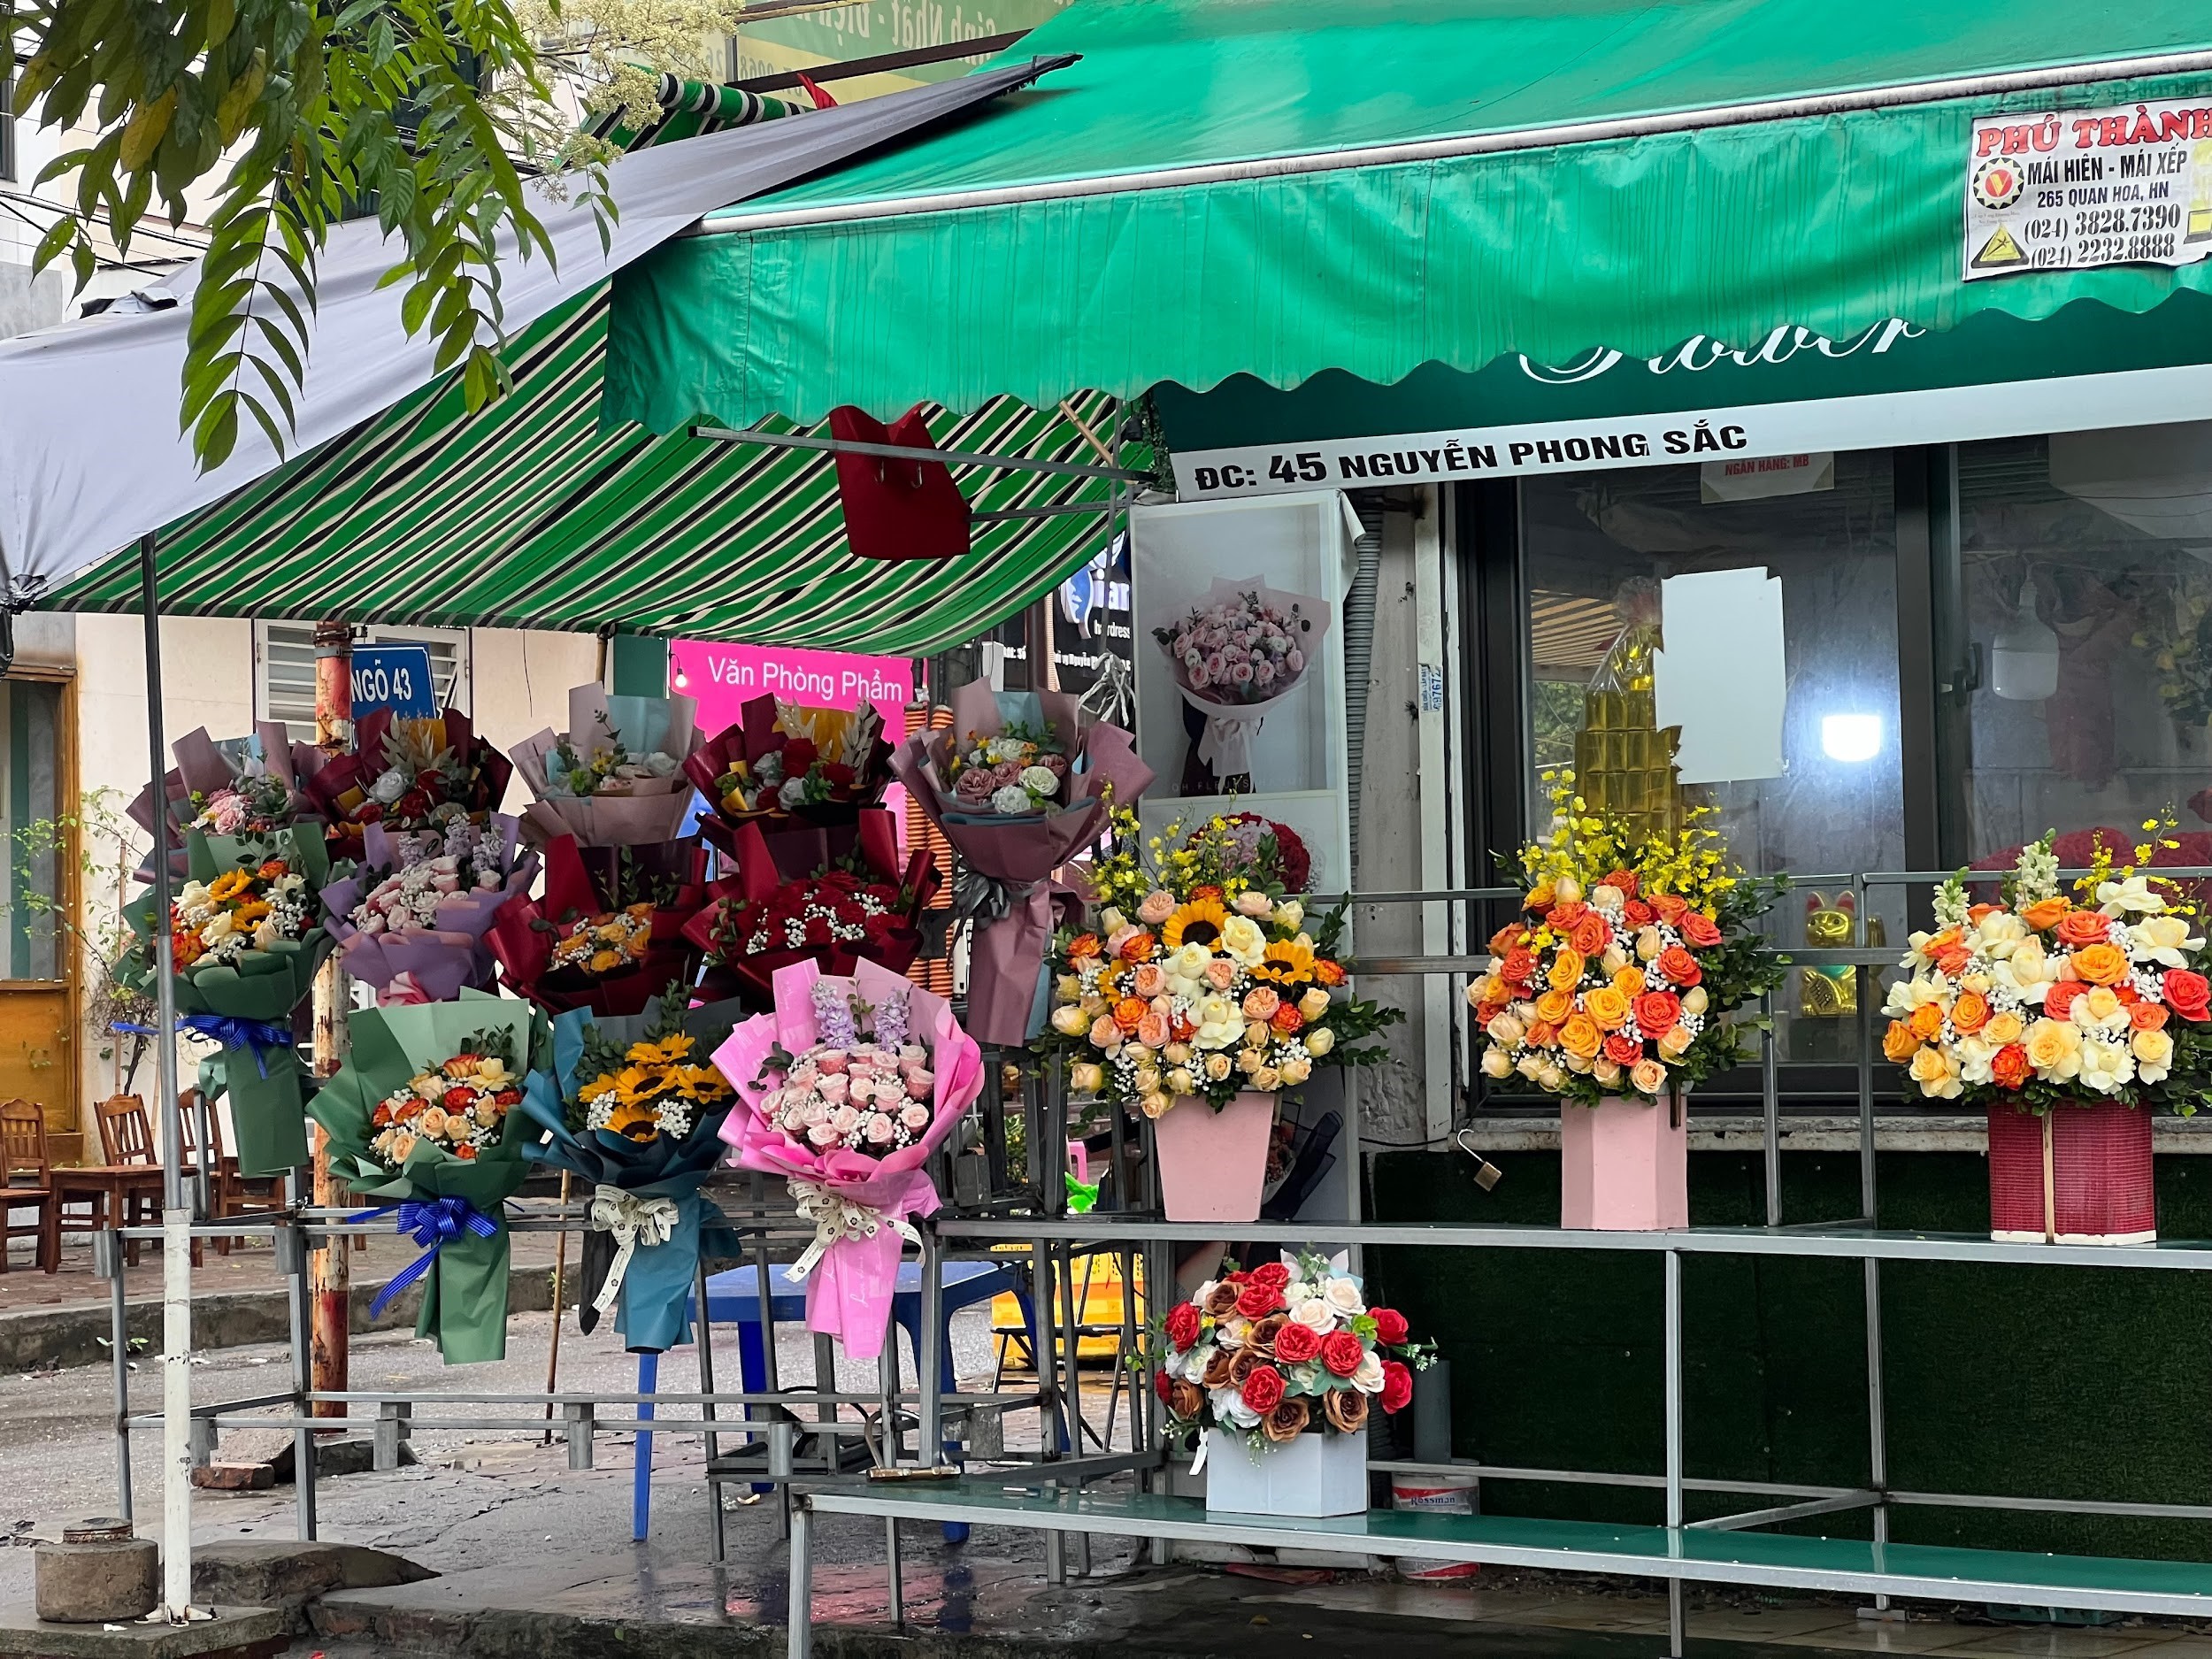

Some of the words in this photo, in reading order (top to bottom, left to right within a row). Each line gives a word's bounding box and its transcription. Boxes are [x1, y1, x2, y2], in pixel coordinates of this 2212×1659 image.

[1977, 113, 2062, 157] PHÚ
[2071, 104, 2212, 149] THÀNH
[2027, 157, 2059, 185] MÁI
[2063, 153, 2104, 182] HIÊN
[2120, 149, 2152, 179] MÁI
[2156, 142, 2188, 175] XẾP
[2037, 190, 2064, 209] 265
[2068, 187, 2108, 207] QUAN
[2112, 184, 2145, 204] HOA,
[2148, 180, 2170, 200] HN
[2024, 218, 2069, 244] (024)
[2074, 203, 2182, 237] 3828.7390
[2078, 232, 2177, 264] 2232.8888
[1194, 465, 1257, 491] ĐC:
[1268, 451, 1327, 484] 45
[1338, 438, 1499, 479] NGUYỄN
[1509, 433, 1651, 465] PHONG
[1663, 418, 1747, 455] SẮC
[351, 658, 389, 703] NGÕ
[393, 667, 412, 701] 43
[708, 656, 755, 687] Văn
[763, 661, 834, 701] Phòng
[841, 669, 902, 702] Phẩm
